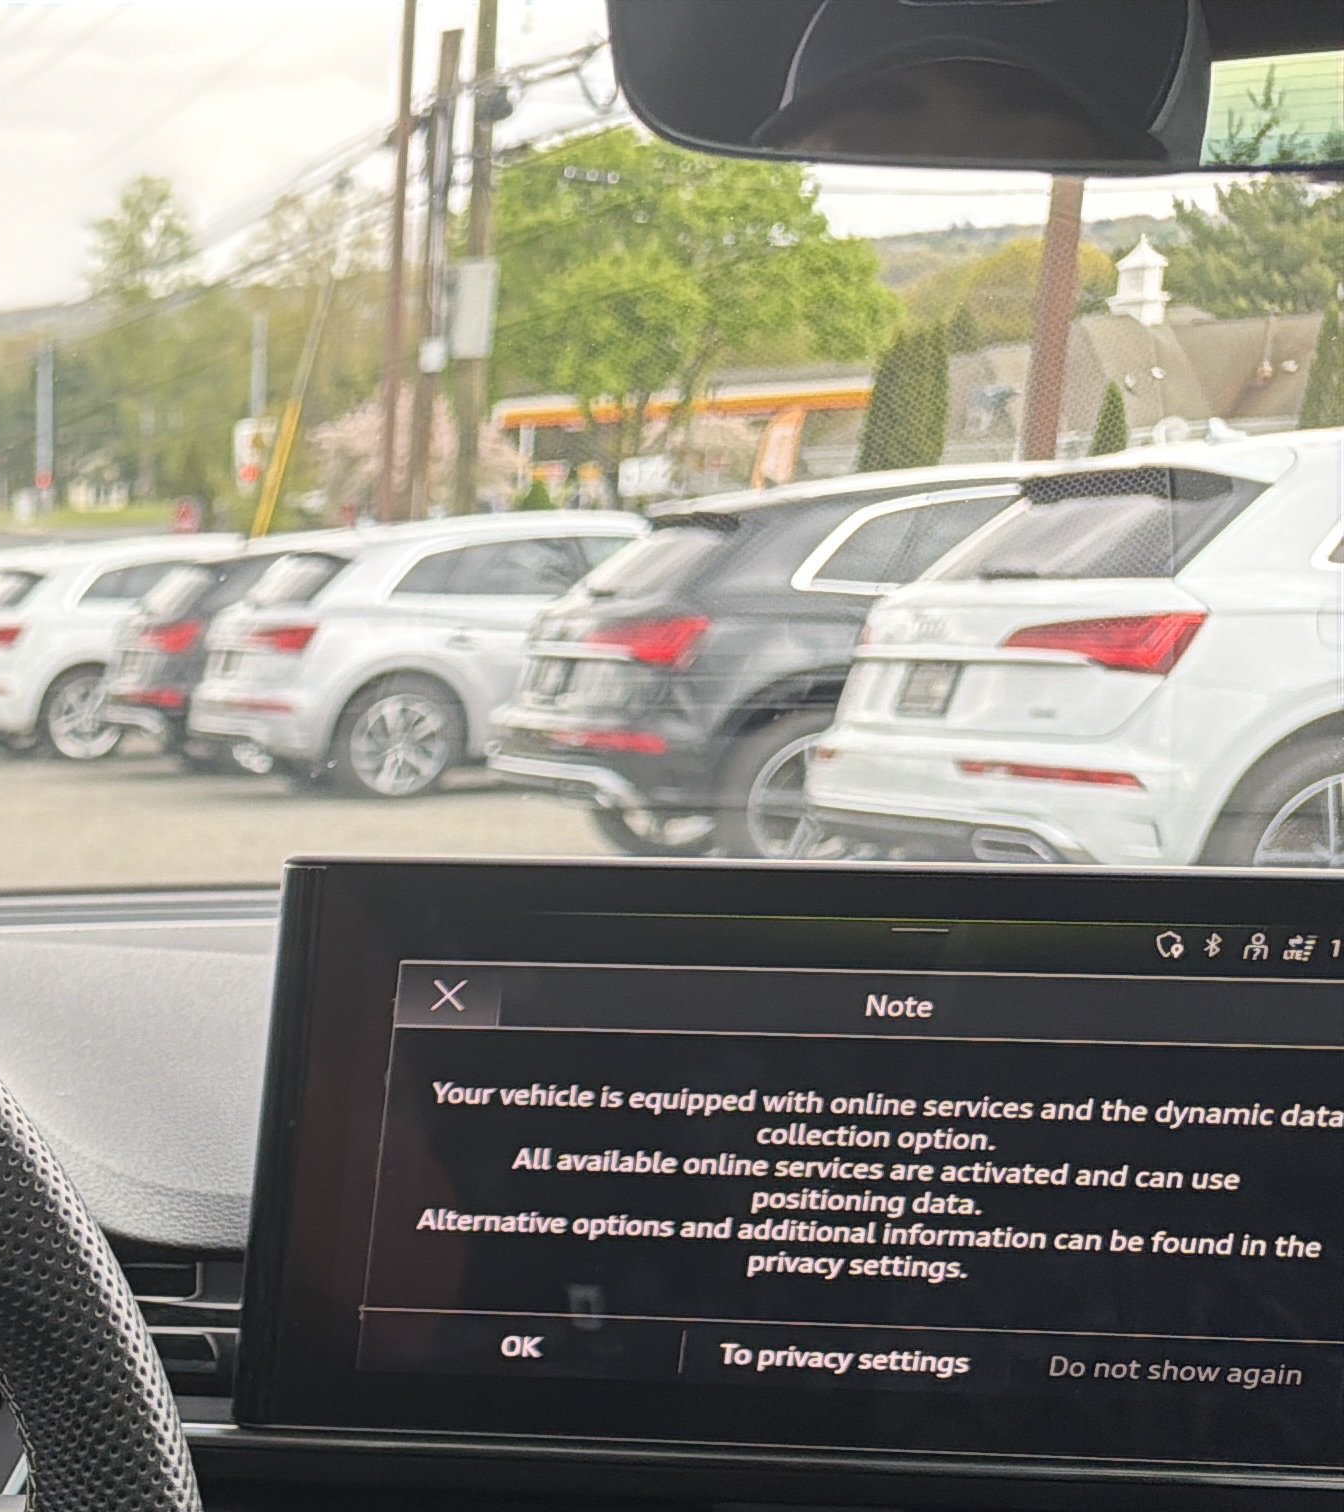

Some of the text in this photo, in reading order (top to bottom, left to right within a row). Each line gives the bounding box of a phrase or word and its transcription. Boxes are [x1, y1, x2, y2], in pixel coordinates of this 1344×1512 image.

[865, 995, 934, 1018] Note
[433, 1081, 1344, 1129] Your vehicle is equipped with online services and the dynamic data
[756, 1123, 997, 1154] collection option.
[512, 1147, 1240, 1191] All available online services are activated and can use
[751, 1190, 982, 1218] positioning data.
[416, 1208, 1322, 1259] Alternative options and additional information can be found in the
[746, 1251, 968, 1284] privacy settings.
[501, 1335, 544, 1359] OK
[720, 1343, 970, 1378] To privacy settings
[1049, 1355, 1302, 1390] Do not show again
